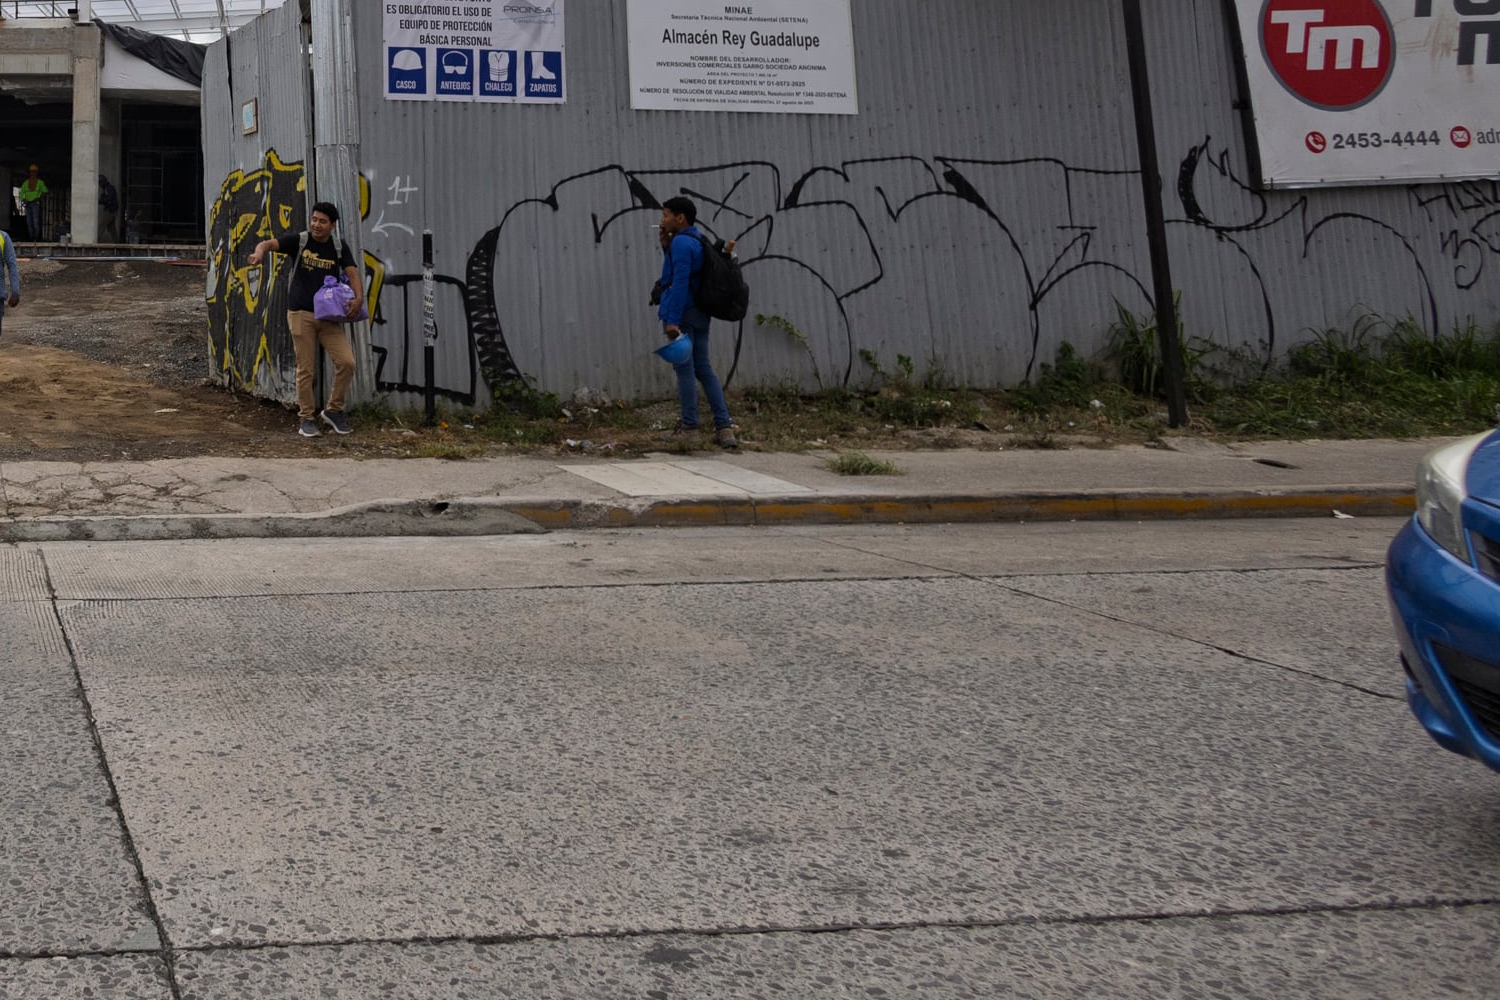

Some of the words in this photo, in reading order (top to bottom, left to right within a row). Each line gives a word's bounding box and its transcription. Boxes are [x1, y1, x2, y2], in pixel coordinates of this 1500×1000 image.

[387, 5, 397, 14] ES
[399, 5, 450, 16] OBLIGATORIO
[452, 6, 462, 16] EL
[464, 7, 479, 16] USO
[481, 8, 492, 17] DE
[503, 6, 553, 14] PROINSA
[725, 6, 752, 14] MINAE
[400, 20, 429, 29] EQUIPO
[431, 20, 441, 30] DE
[443, 20, 493, 31] PROTECCIÓN
[419, 34, 449, 45] BÁSICA
[451, 36, 493, 46] PERSONAL
[662, 28, 717, 45] Almacén
[722, 30, 746, 49] Rey
[750, 31, 820, 51] Guadalupe
[396, 80, 416, 89] CASCO
[440, 81, 471, 90] ANTEOJOS
[485, 82, 513, 92] CHALECO
[530, 83, 557, 92] ZAPATOS
[1332, 130, 1440, 149] 2453-4444
